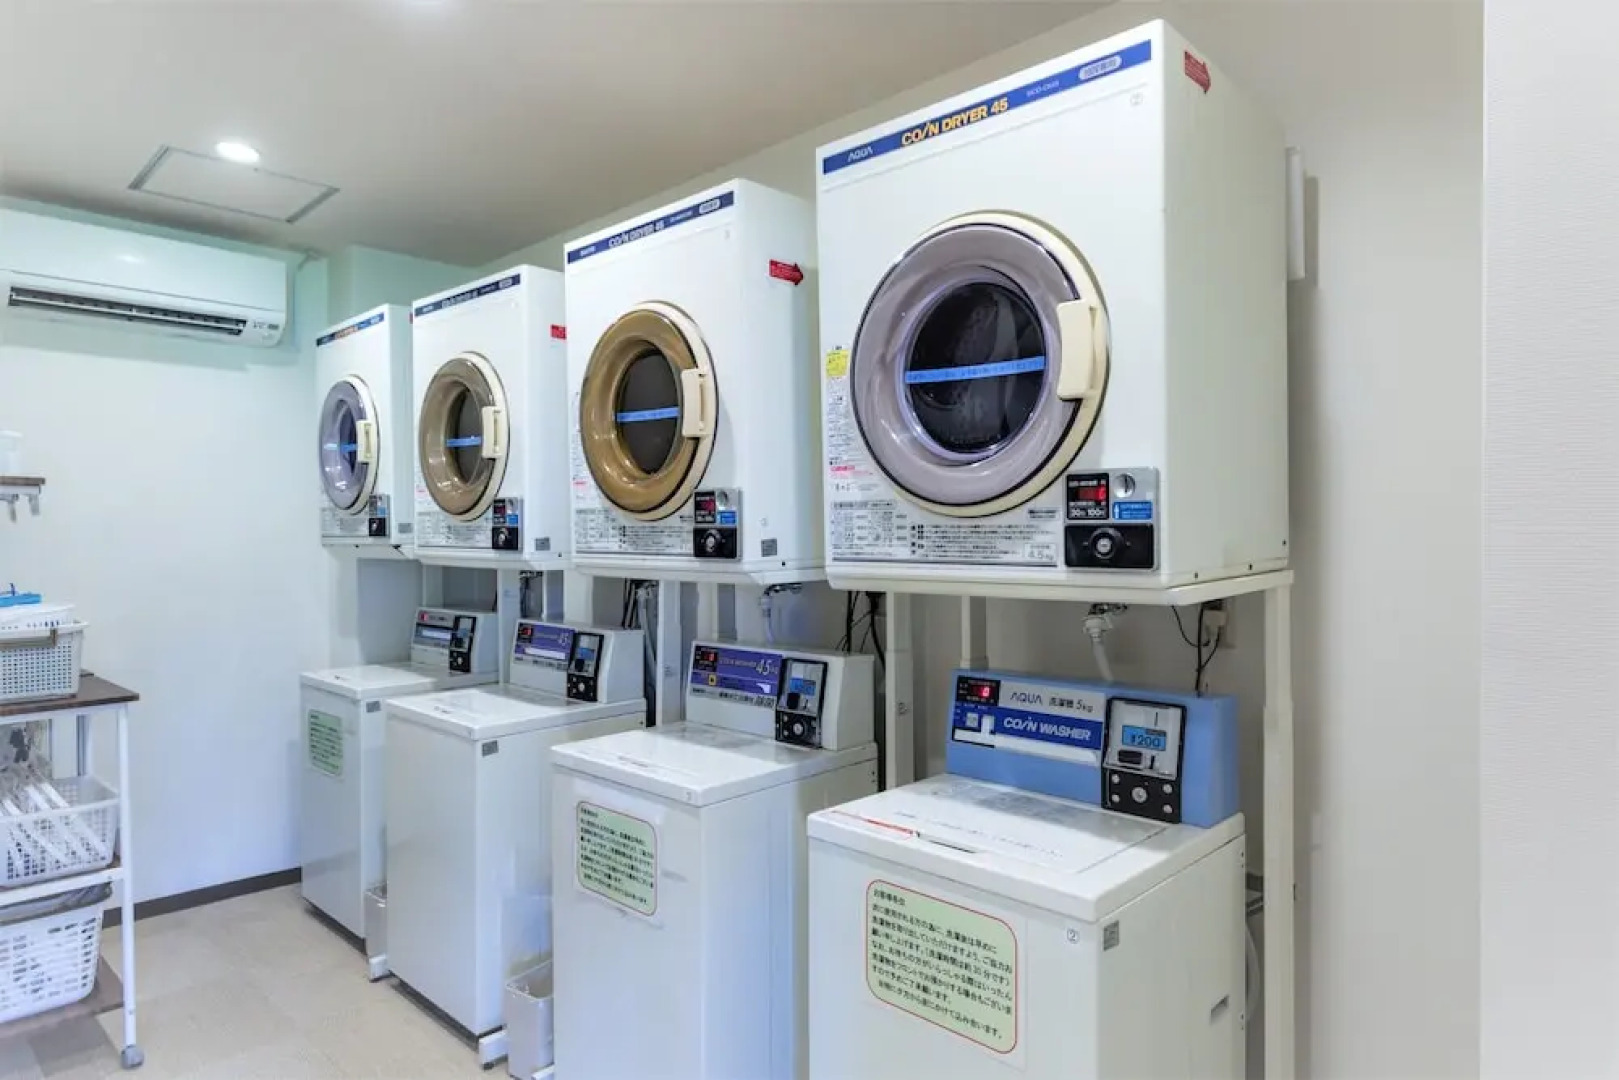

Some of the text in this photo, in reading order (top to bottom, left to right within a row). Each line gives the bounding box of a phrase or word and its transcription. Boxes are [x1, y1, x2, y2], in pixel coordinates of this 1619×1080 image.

[901, 121, 940, 147] COIN
[942, 104, 988, 131] DRYER
[1010, 692, 1043, 706] AQUA
[1003, 715, 1092, 741] COIN WASHER
